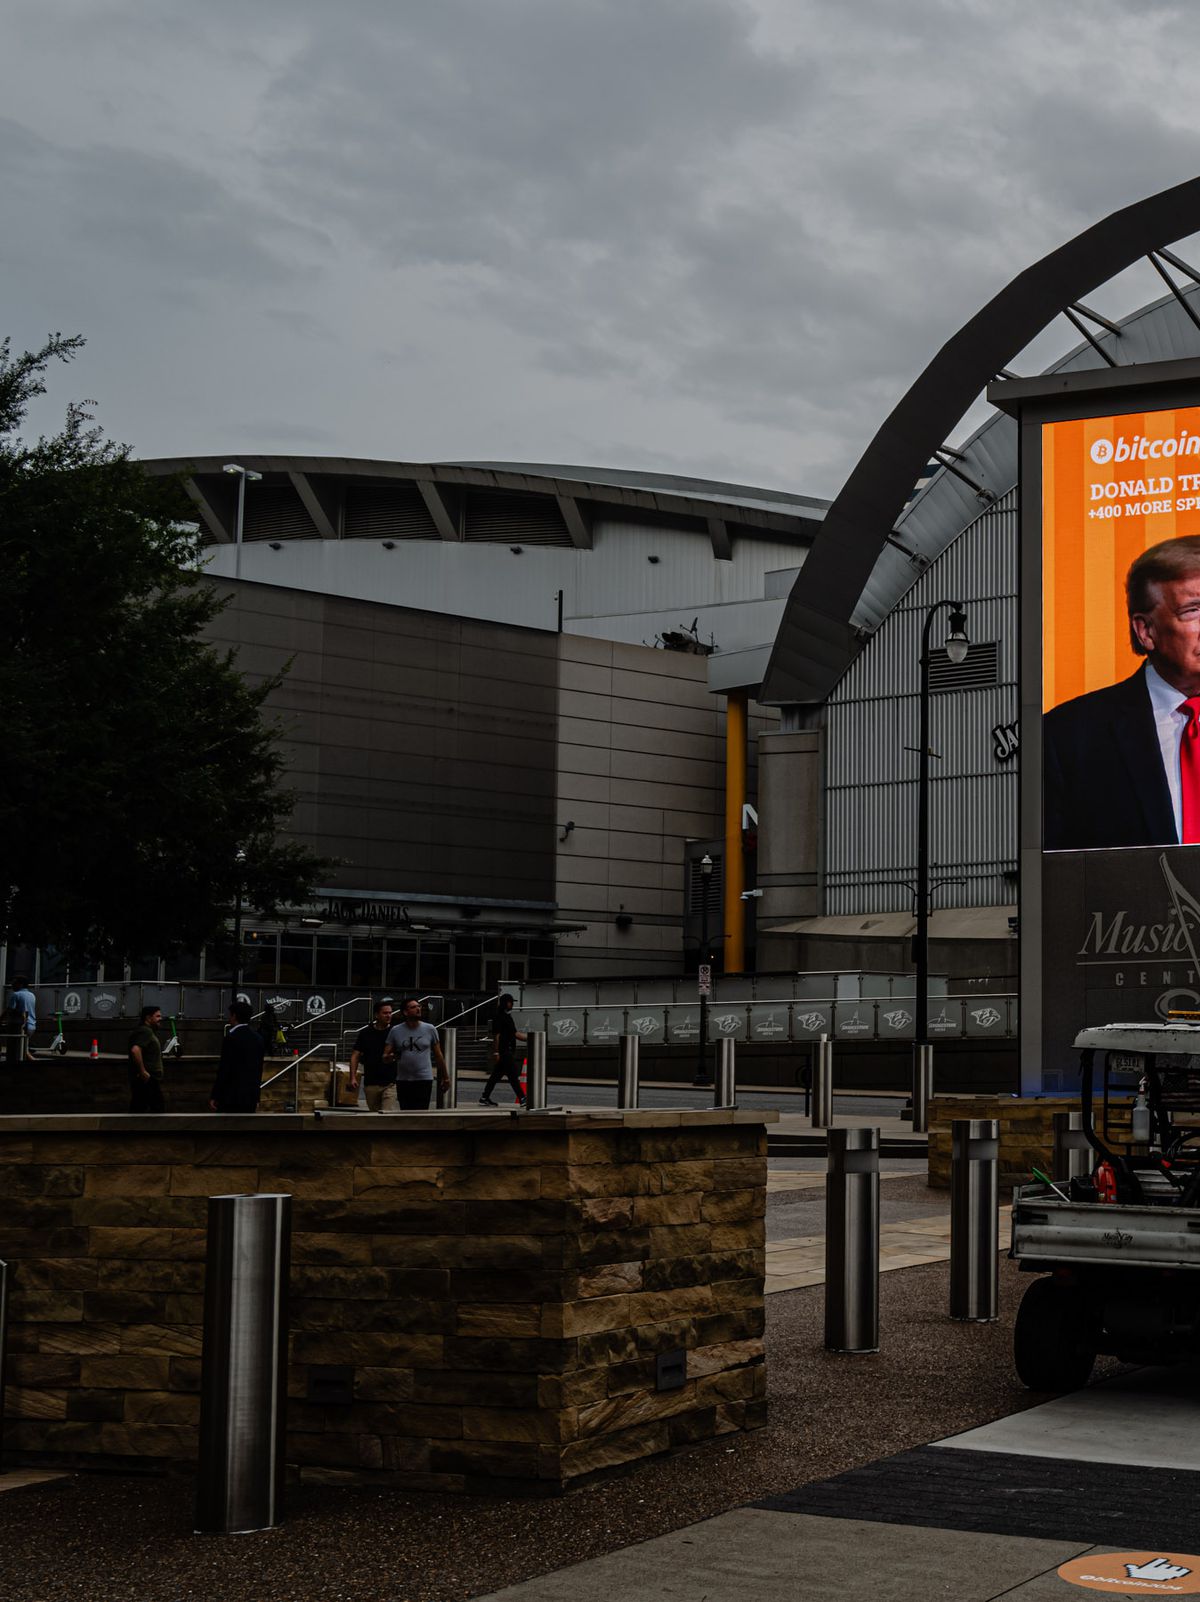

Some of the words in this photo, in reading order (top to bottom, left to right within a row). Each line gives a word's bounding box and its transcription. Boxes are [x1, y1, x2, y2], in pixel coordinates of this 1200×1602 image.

[1090, 477, 1174, 500] DONALD
[1088, 504, 1122, 519] +400
[1125, 499, 1172, 516] MORE
[1076, 904, 1196, 955] Music
